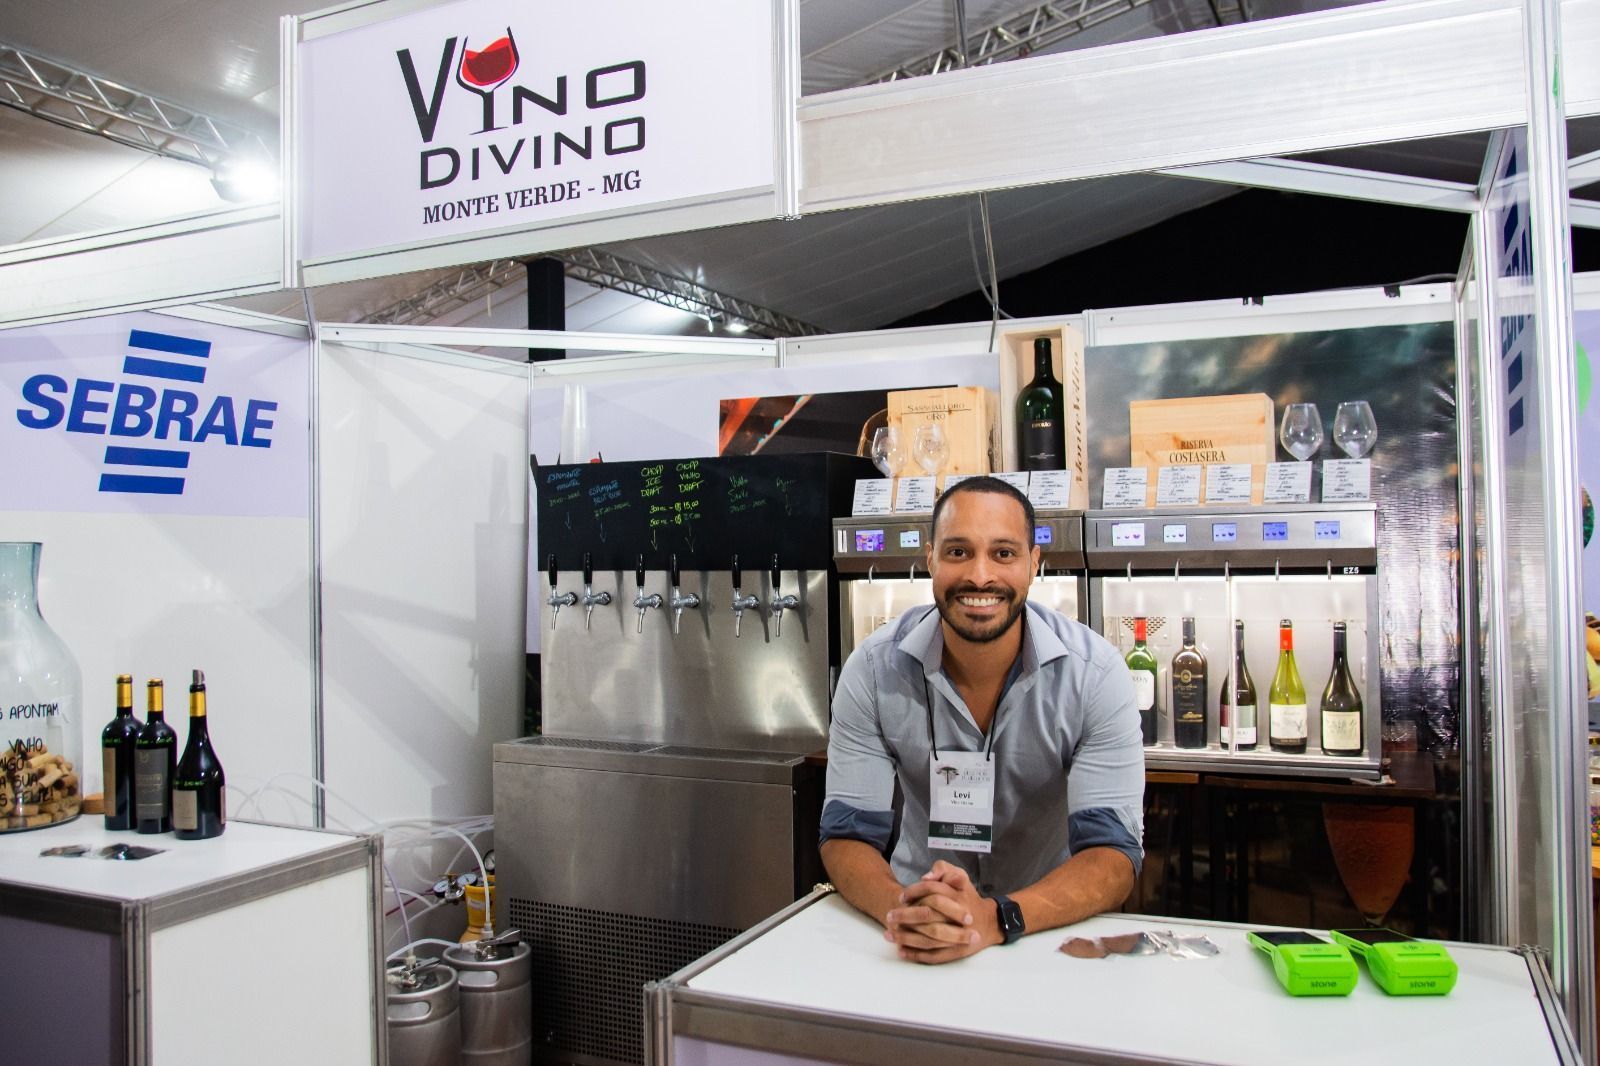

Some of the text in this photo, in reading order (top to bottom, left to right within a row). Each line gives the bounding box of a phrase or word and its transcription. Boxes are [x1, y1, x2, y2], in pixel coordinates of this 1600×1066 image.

[420, 116, 646, 190] DIVINO
[423, 194, 500, 224] MONTE
[505, 179, 581, 210] VERDE
[602, 169, 642, 195] MG
[16, 373, 278, 448] SEBRAE
[1180, 439, 1214, 450] RISERVA
[1169, 450, 1226, 464] COSTASERA
[646, 477, 661, 488] ICE
[10, 703, 60, 720] APONTAM
[8, 737, 43, 754] VINHO
[953, 790, 971, 799] Levi
[1310, 980, 1337, 988] stone
[1409, 980, 1436, 988] stone
